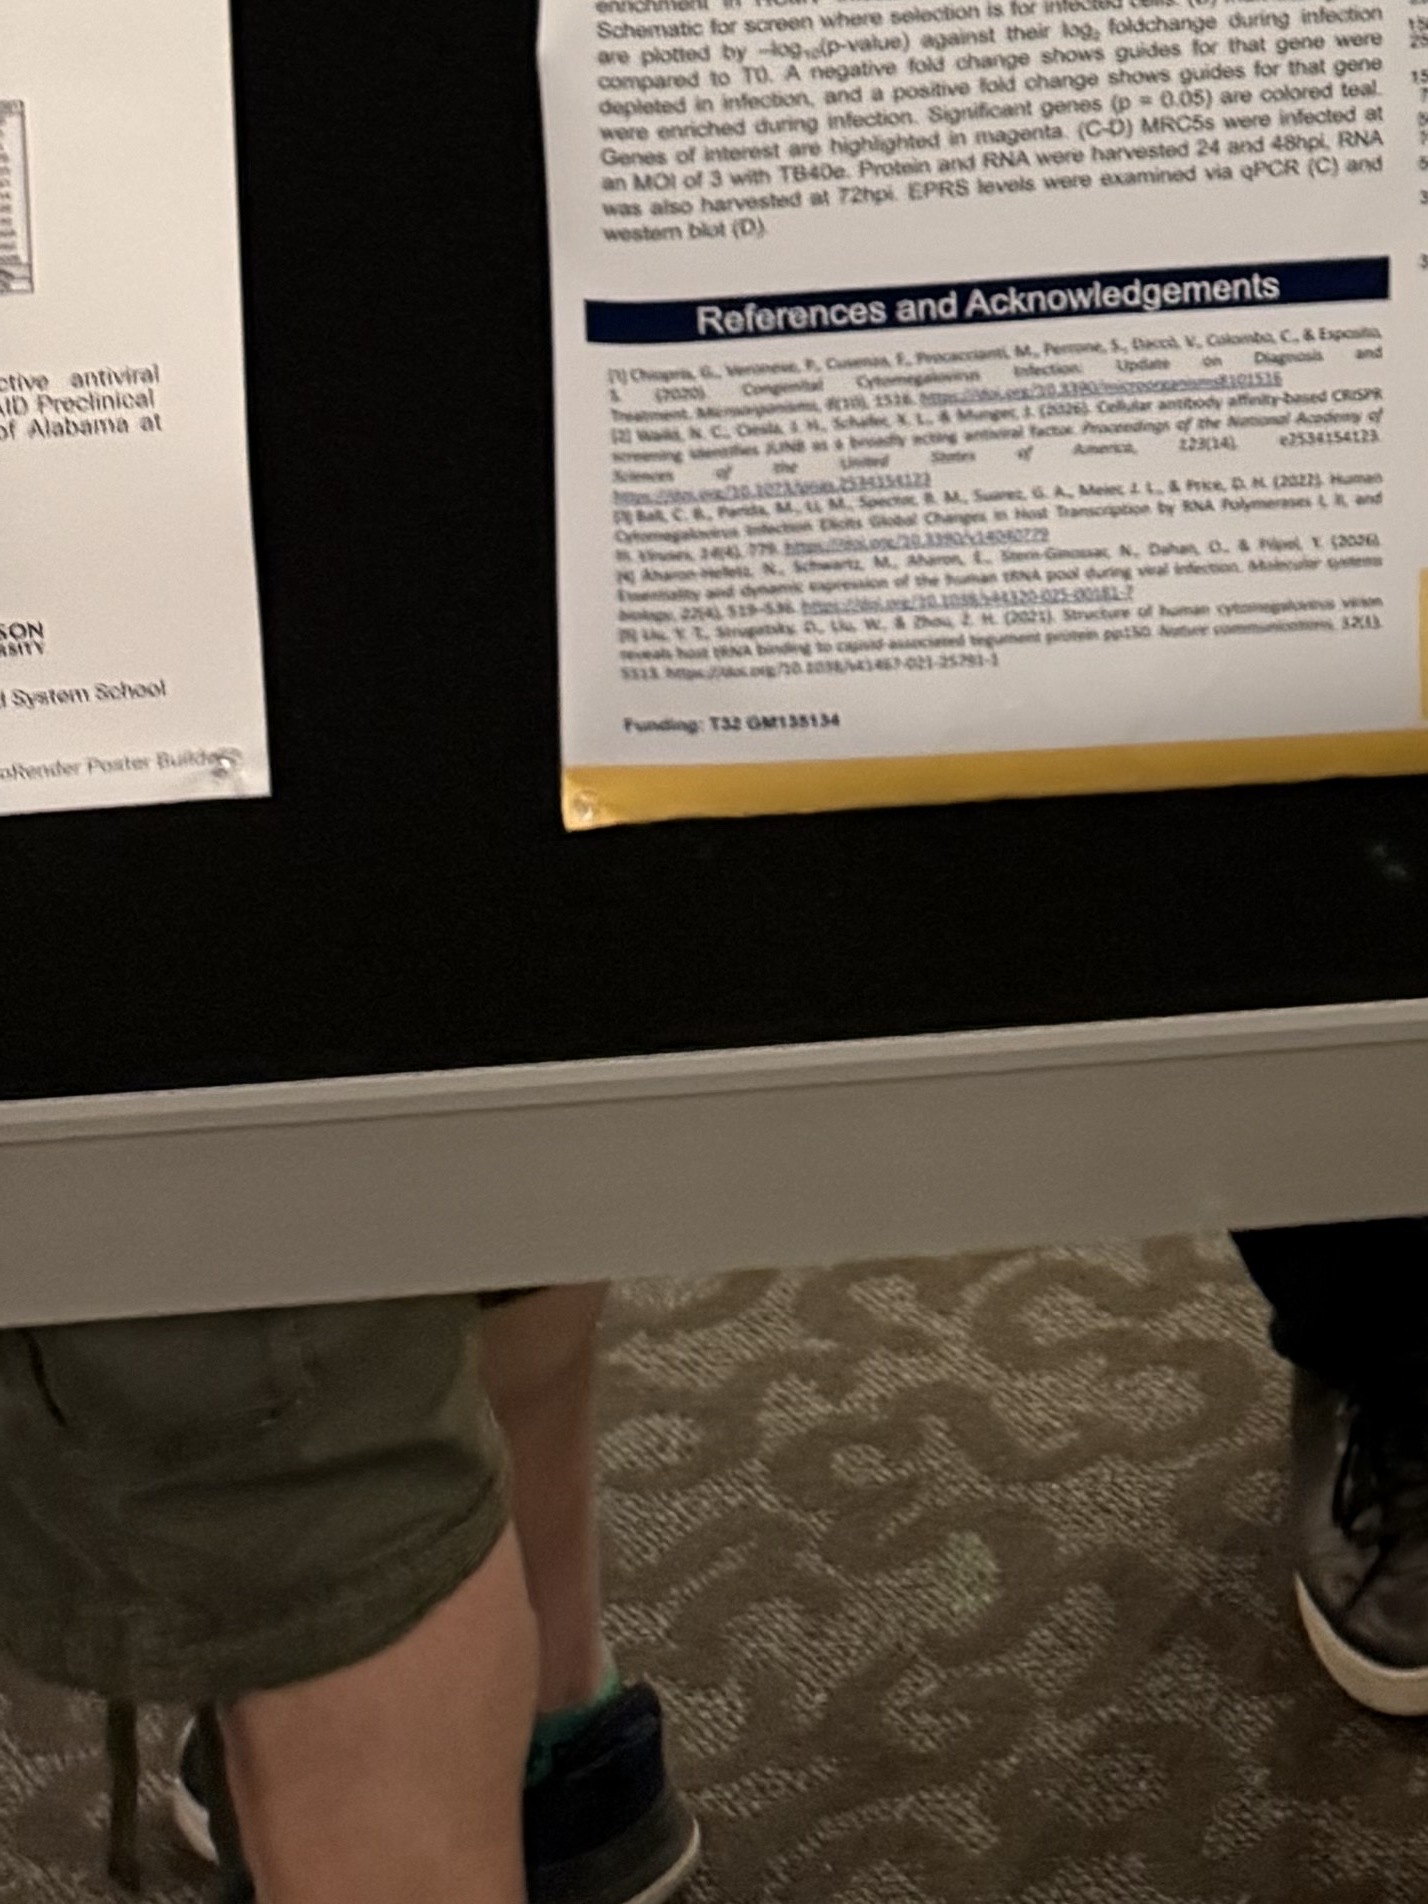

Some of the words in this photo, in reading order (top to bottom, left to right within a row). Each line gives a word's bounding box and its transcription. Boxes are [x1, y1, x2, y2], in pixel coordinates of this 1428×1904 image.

[697, 301, 888, 335] References
[895, 290, 958, 323] and
[964, 273, 1281, 318] Acknowledgements
[70, 363, 160, 389] antiviral
[37, 387, 155, 414] Preclinical
[28, 415, 129, 439] Alabama
[708, 716, 742, 732] T32
